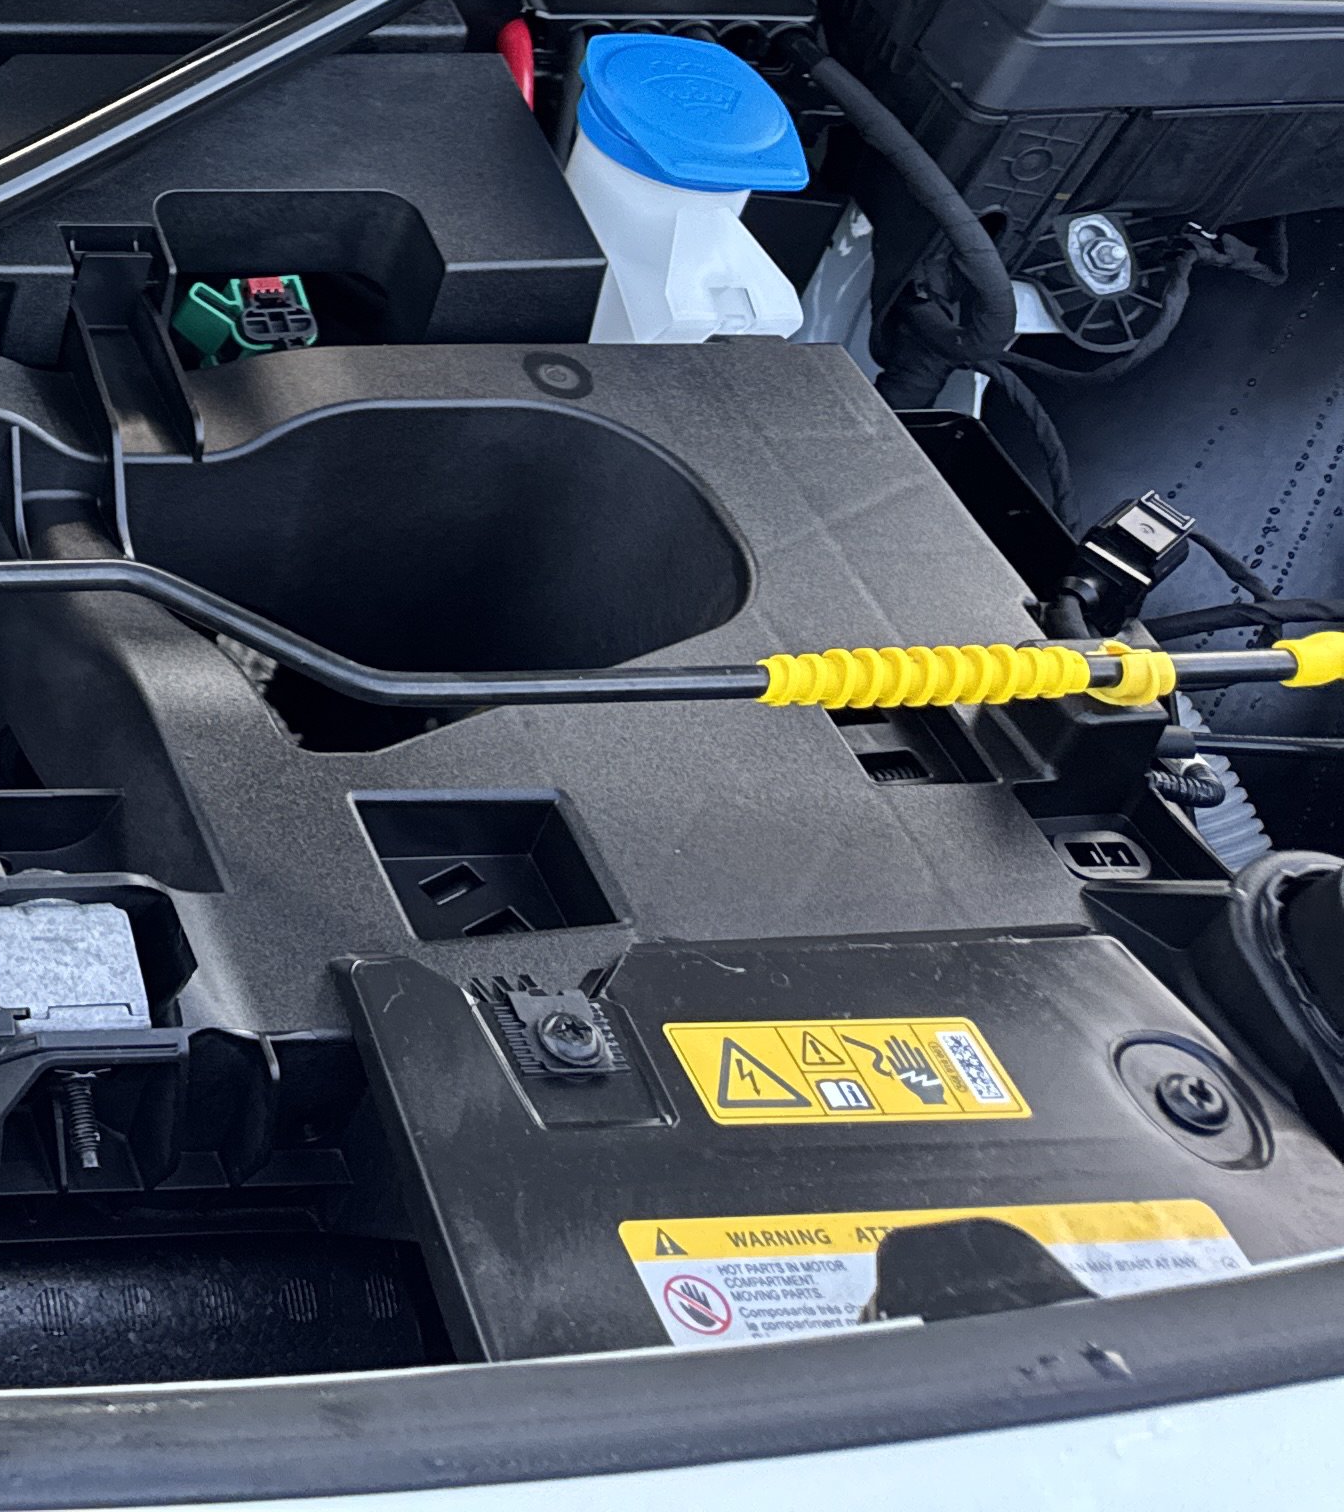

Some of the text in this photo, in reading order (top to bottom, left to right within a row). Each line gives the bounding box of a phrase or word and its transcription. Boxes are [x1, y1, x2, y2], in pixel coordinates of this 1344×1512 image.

[725, 1230, 833, 1248] WARNING
[716, 1260, 847, 1276] HOT PARTS IN MOTOR
[730, 1289, 781, 1302] MOVING
[739, 1304, 816, 1319] Composants
[761, 1317, 843, 1332] compartiment
